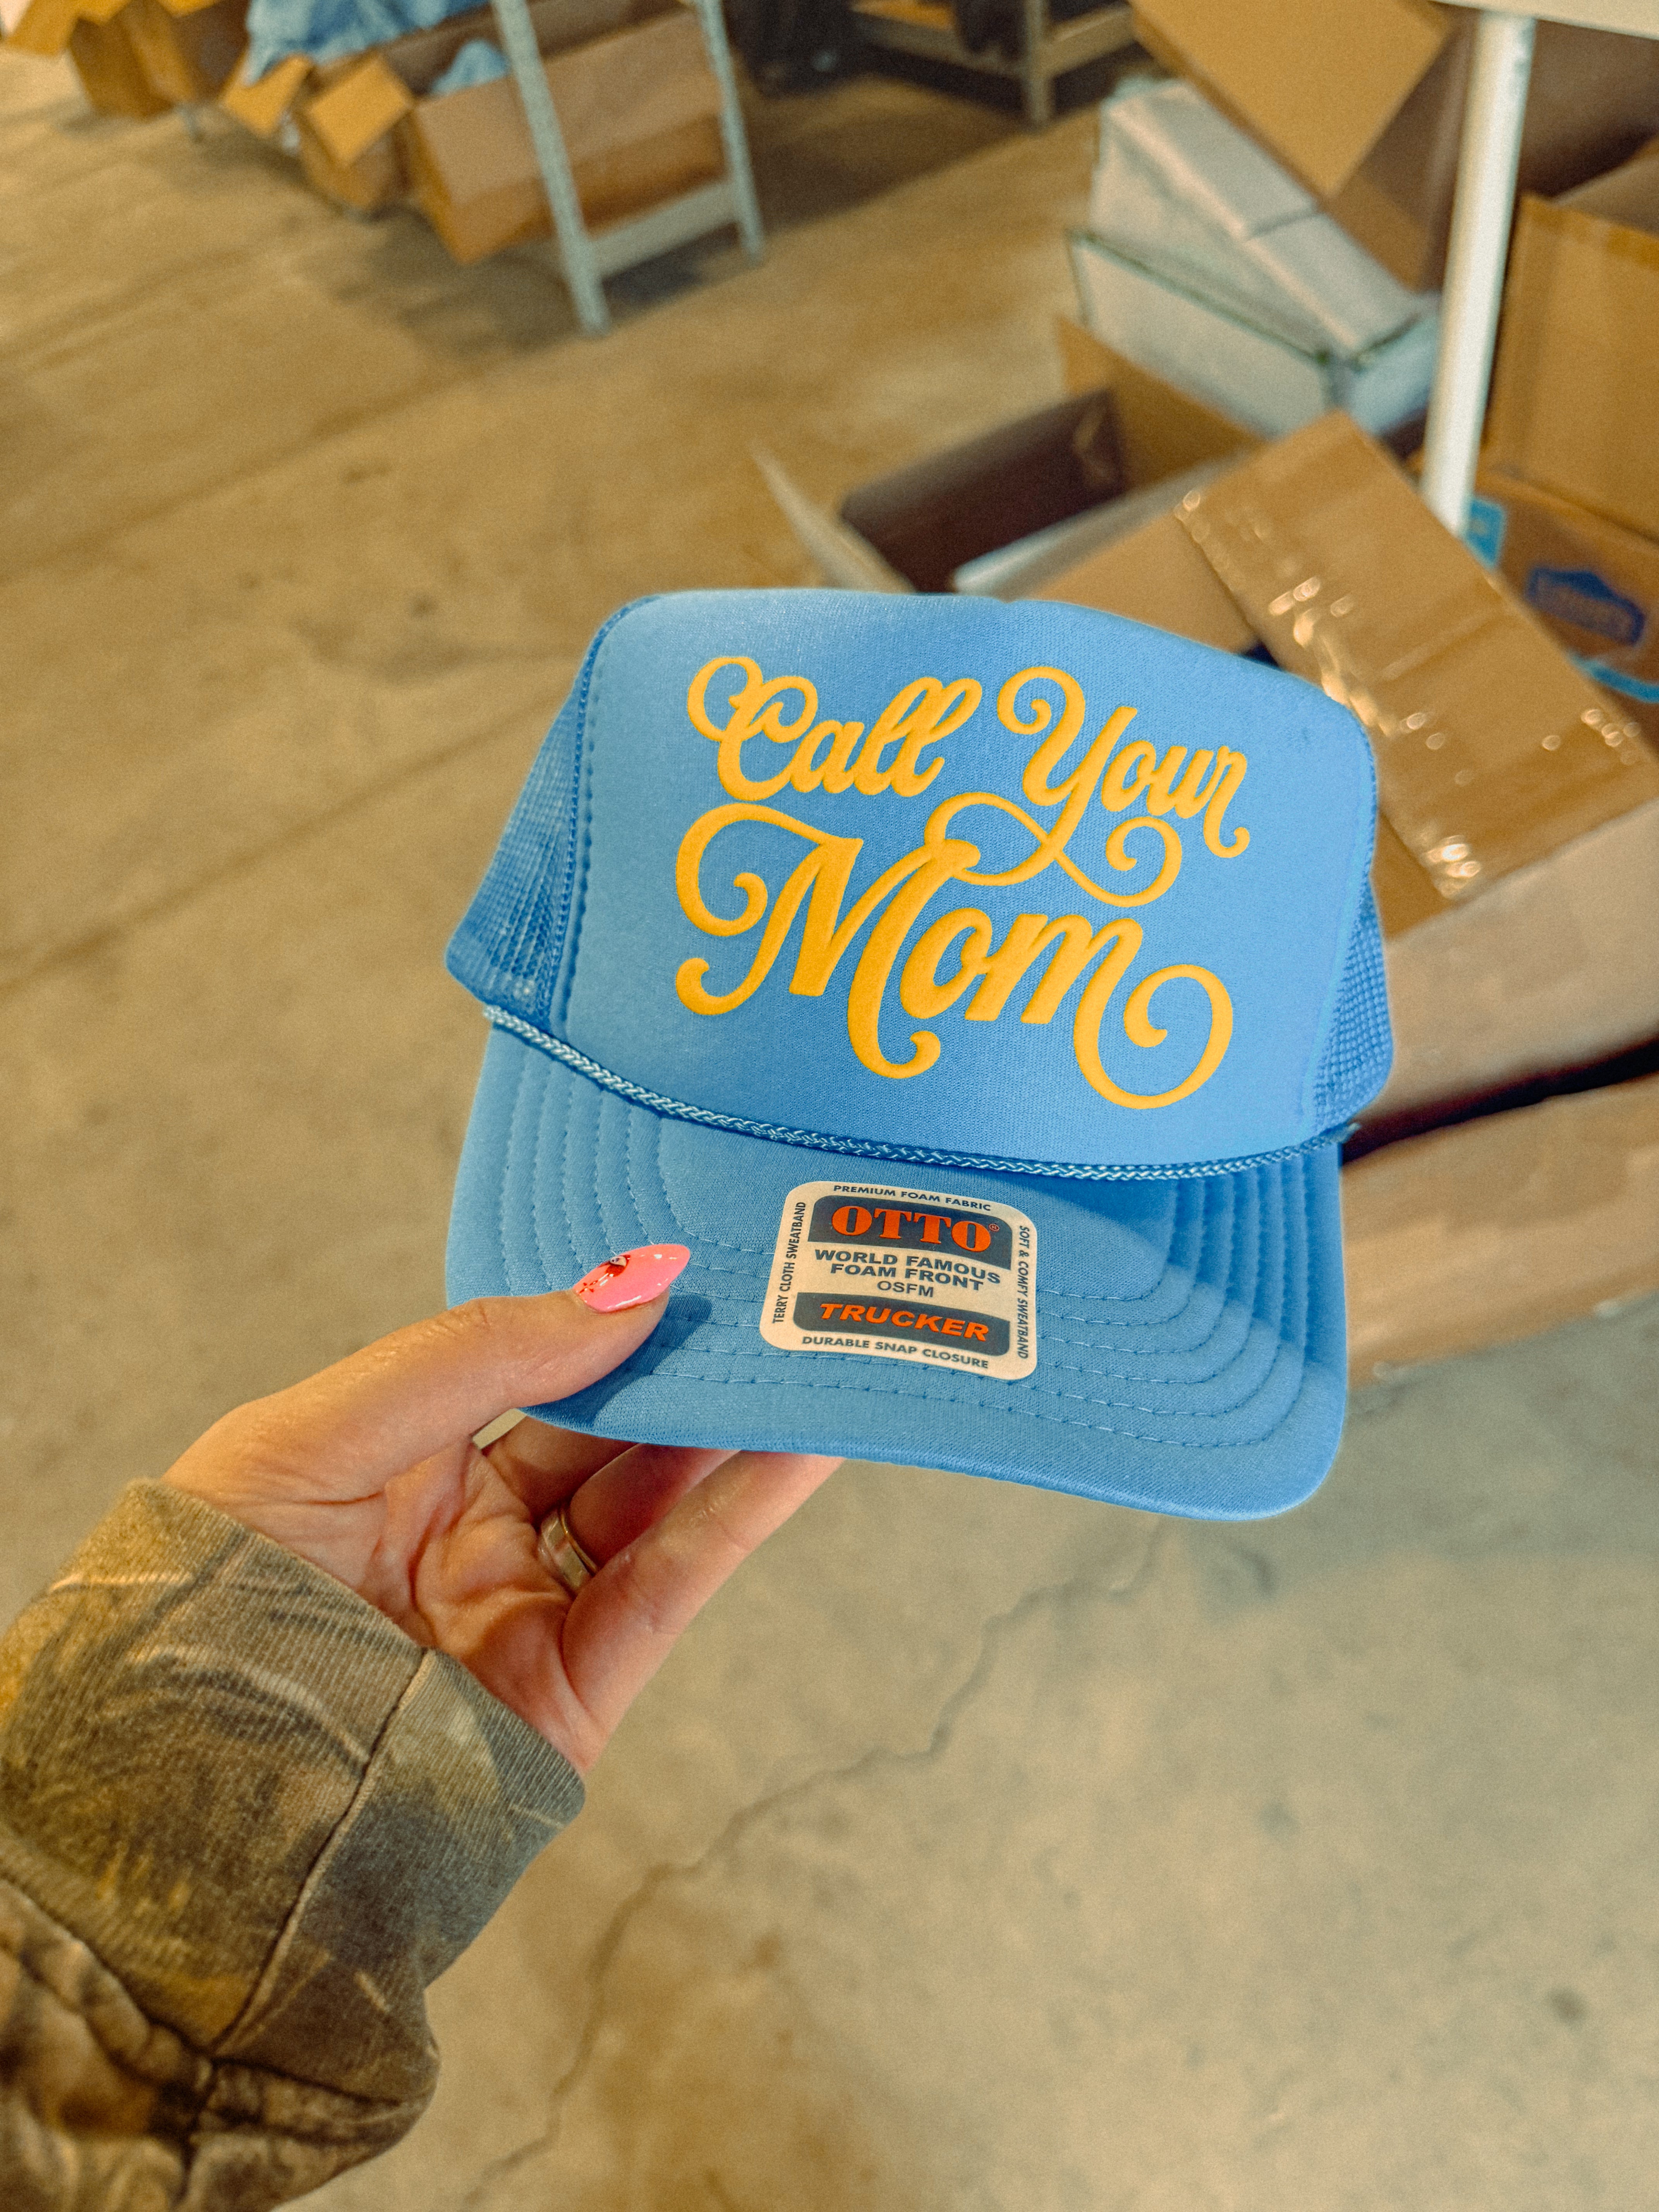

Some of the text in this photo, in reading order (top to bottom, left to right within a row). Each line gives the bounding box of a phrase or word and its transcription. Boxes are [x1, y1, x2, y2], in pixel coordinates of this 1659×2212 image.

[687, 656, 1250, 907] Call Your
[676, 803, 1233, 1109] Mom
[833, 1185, 991, 1211] PREMIUM FOAM FABRIC
[832, 1206, 991, 1252] OTTO
[1019, 1225, 1030, 1248] SOFT
[773, 1202, 806, 1324] TERRY CLOTH SWEATBAND
[815, 1250, 1001, 1284] WORLD FAMOUS
[830, 1264, 984, 1291] FOAM FRONT
[1017, 1260, 1028, 1297] COMFY
[877, 1281, 934, 1298] OSFM
[820, 1304, 989, 1342] TRUCKER
[1017, 1300, 1028, 1358] SWEATBAND
[802, 1336, 989, 1369] DURABLE SNAP CLOSURE
